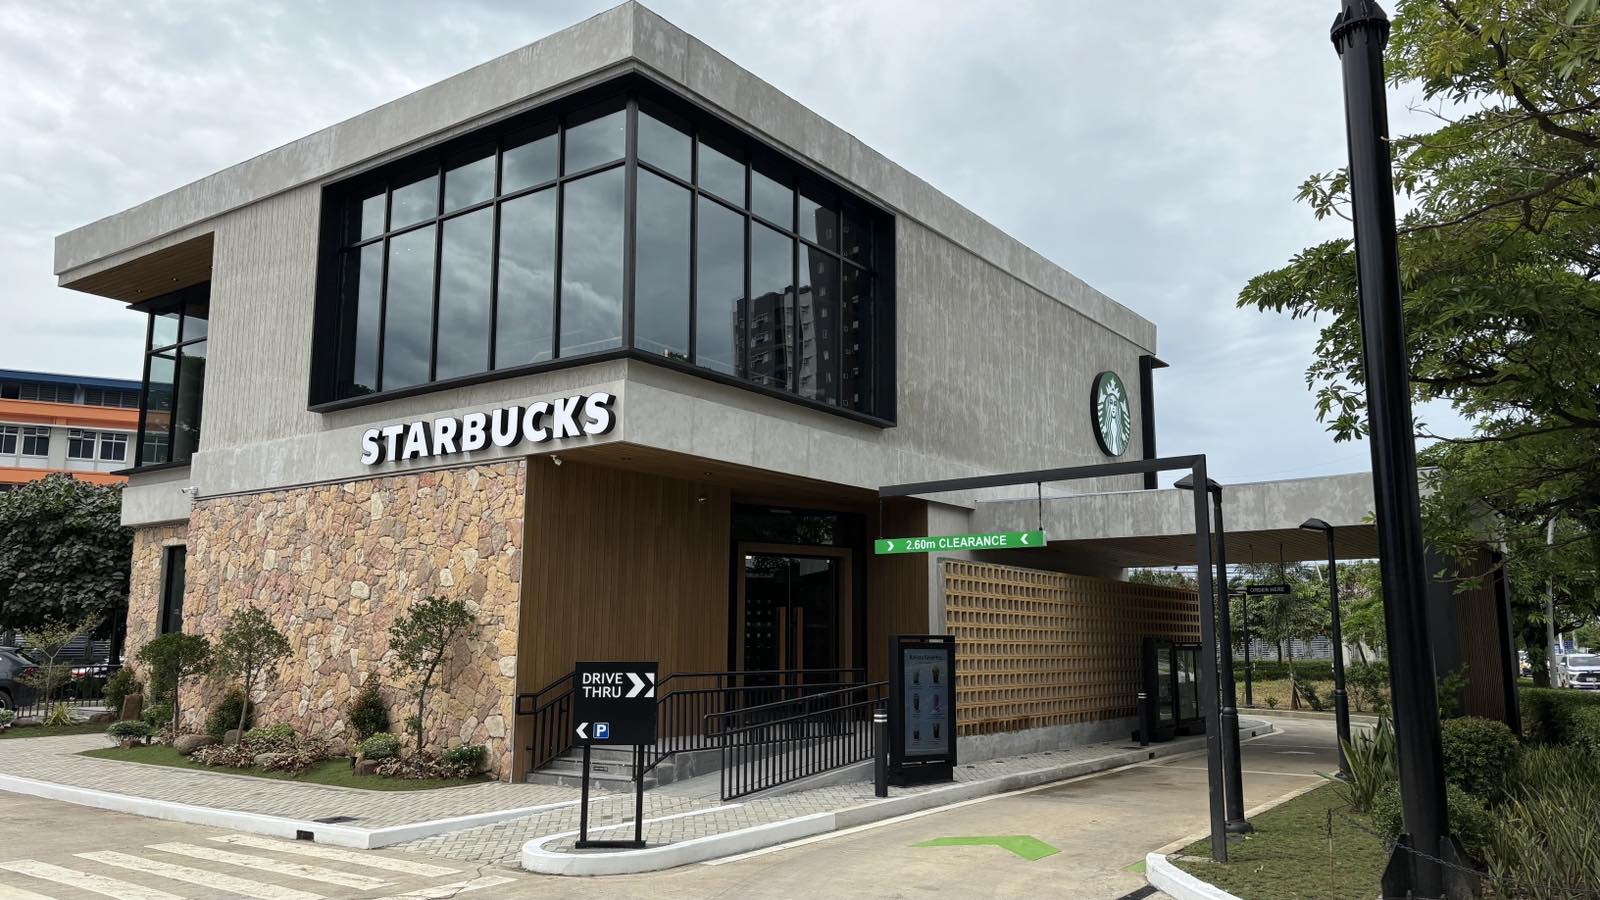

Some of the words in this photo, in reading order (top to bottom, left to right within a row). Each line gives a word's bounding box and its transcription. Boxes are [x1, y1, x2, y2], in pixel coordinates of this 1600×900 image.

[360, 392, 616, 465] STARBUCKS
[906, 539, 936, 550] 2.60m
[938, 535, 1007, 548] CLEARANCE
[582, 672, 623, 684] DRIVE
[582, 686, 621, 698] THRU
[596, 724, 606, 737] P
